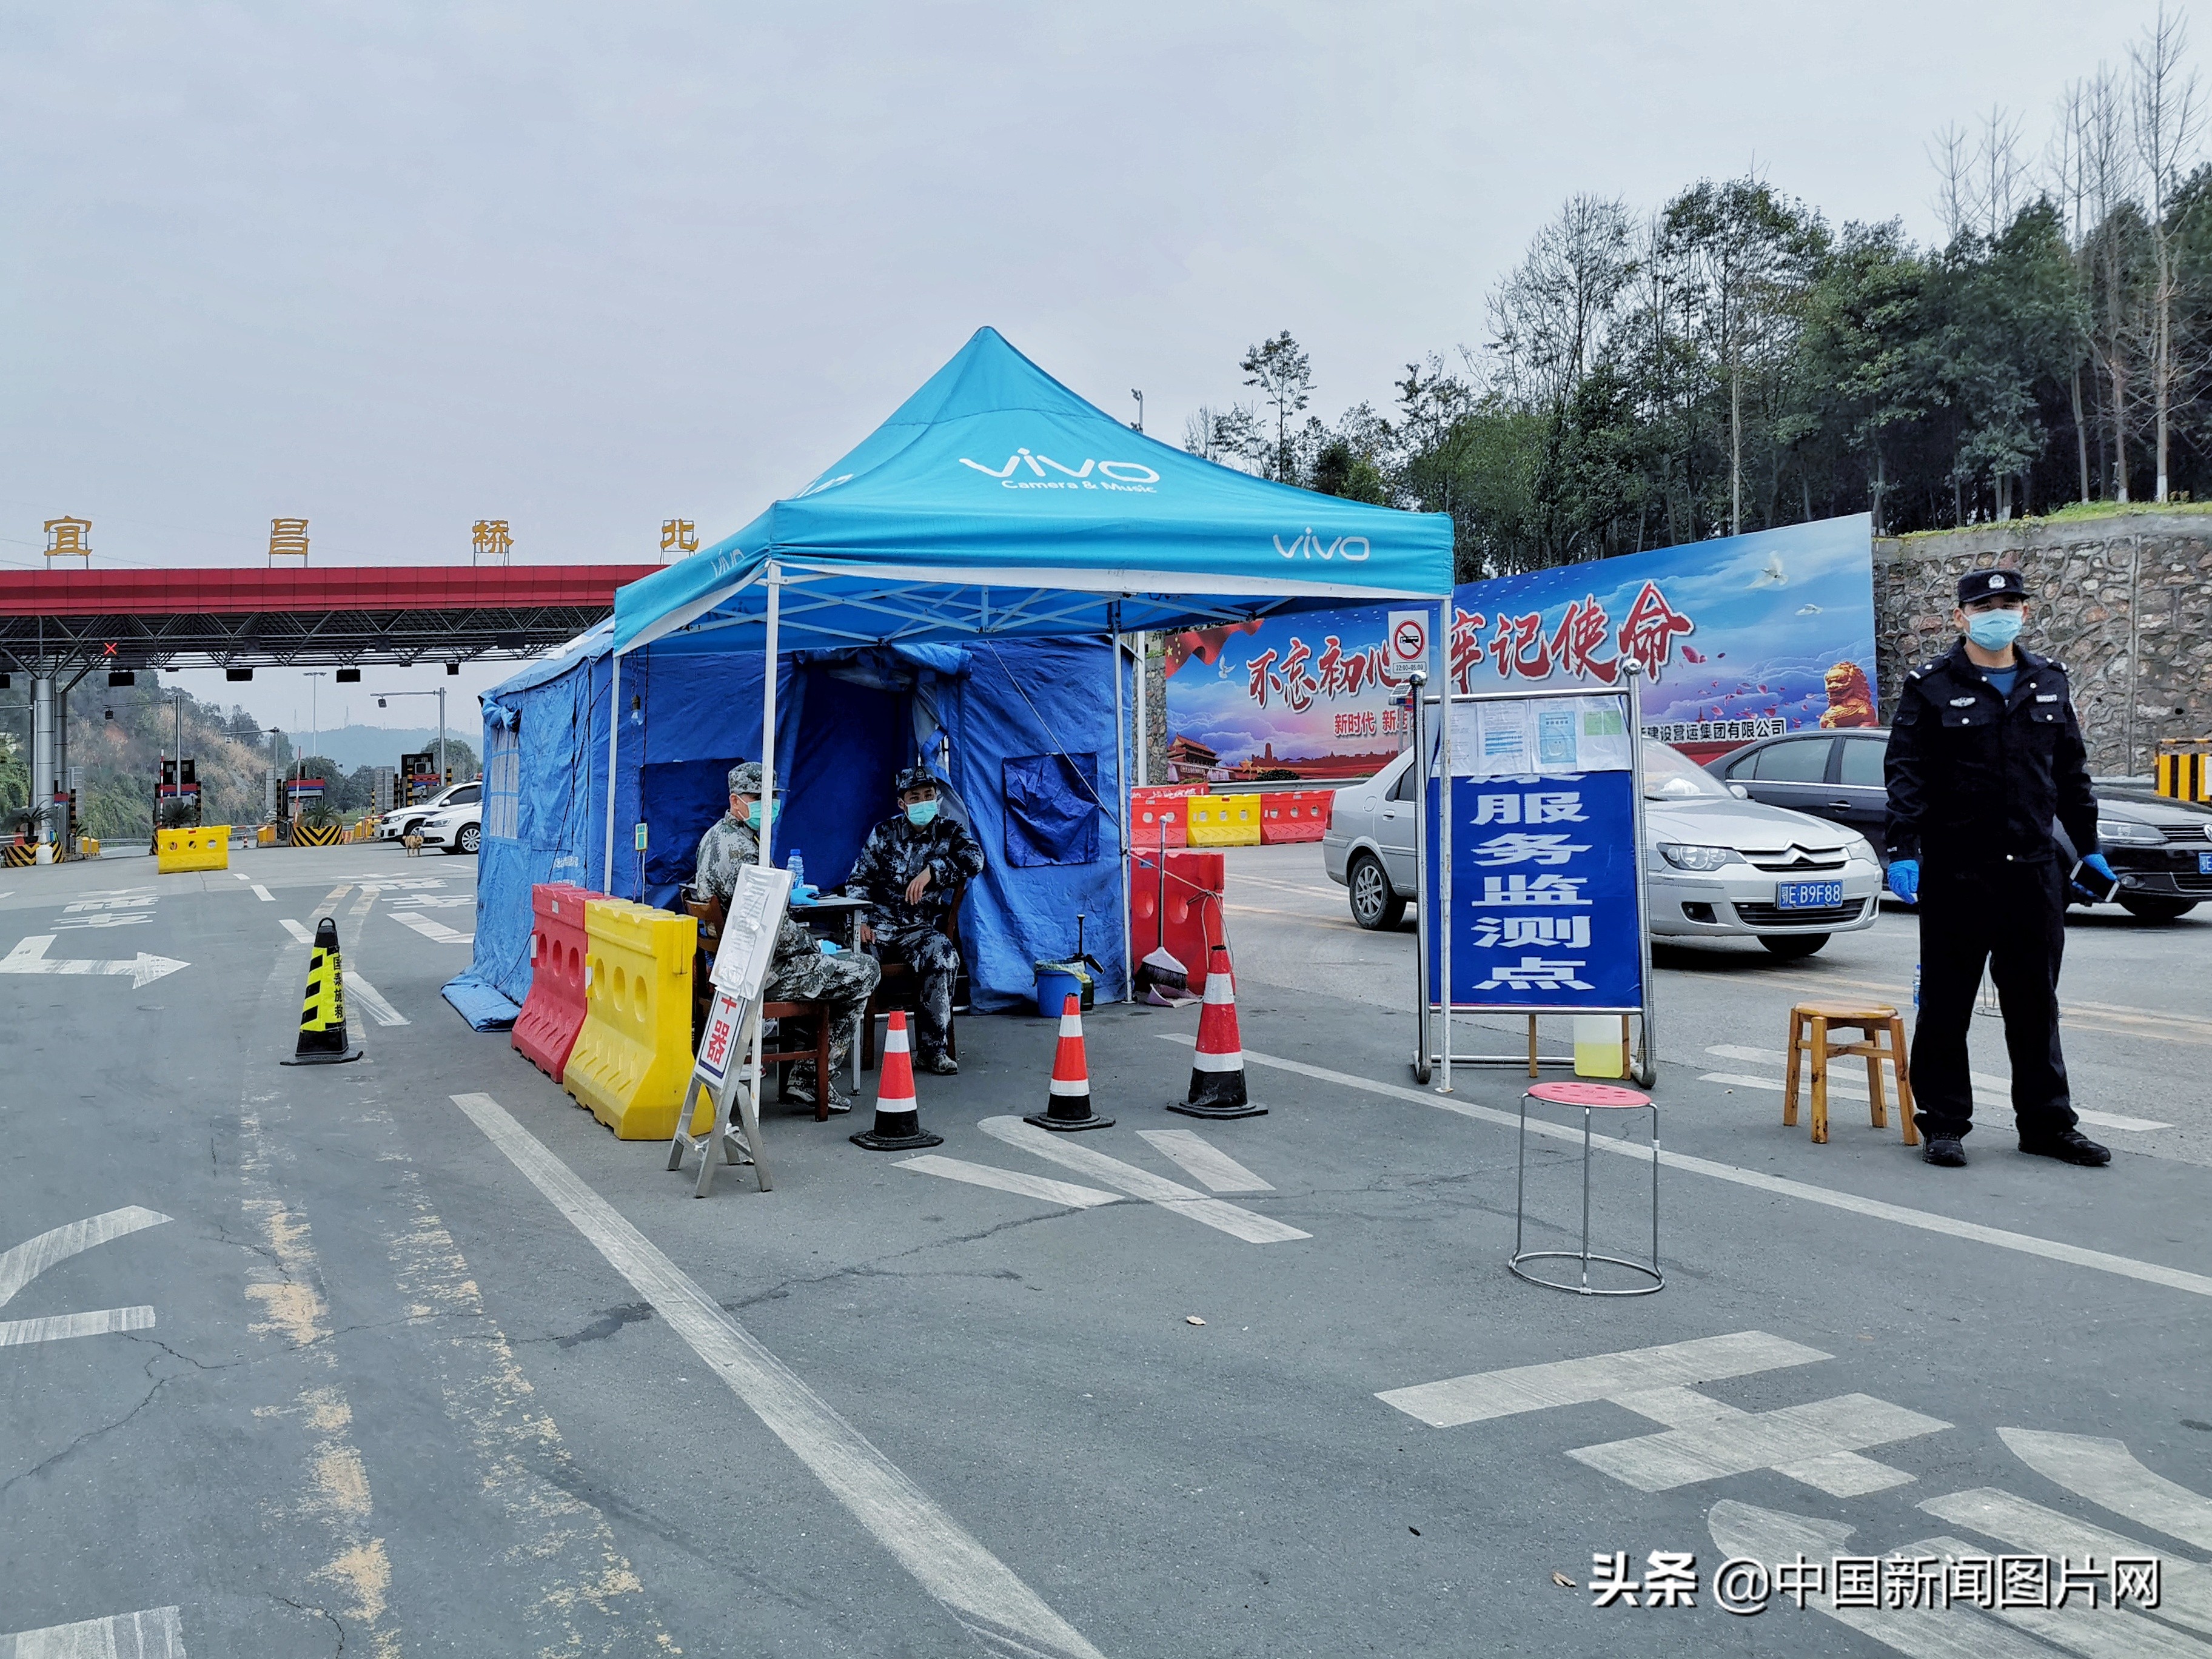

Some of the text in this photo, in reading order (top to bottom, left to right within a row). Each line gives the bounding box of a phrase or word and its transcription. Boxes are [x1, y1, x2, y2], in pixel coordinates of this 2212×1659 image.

[959, 447, 1161, 483] vivo
[1001, 480, 1158, 493] Camera & Music
[1272, 526, 1370, 561] vivo
[1450, 580, 1695, 695] 牢记使命
[1334, 711, 1375, 735] 新时代
